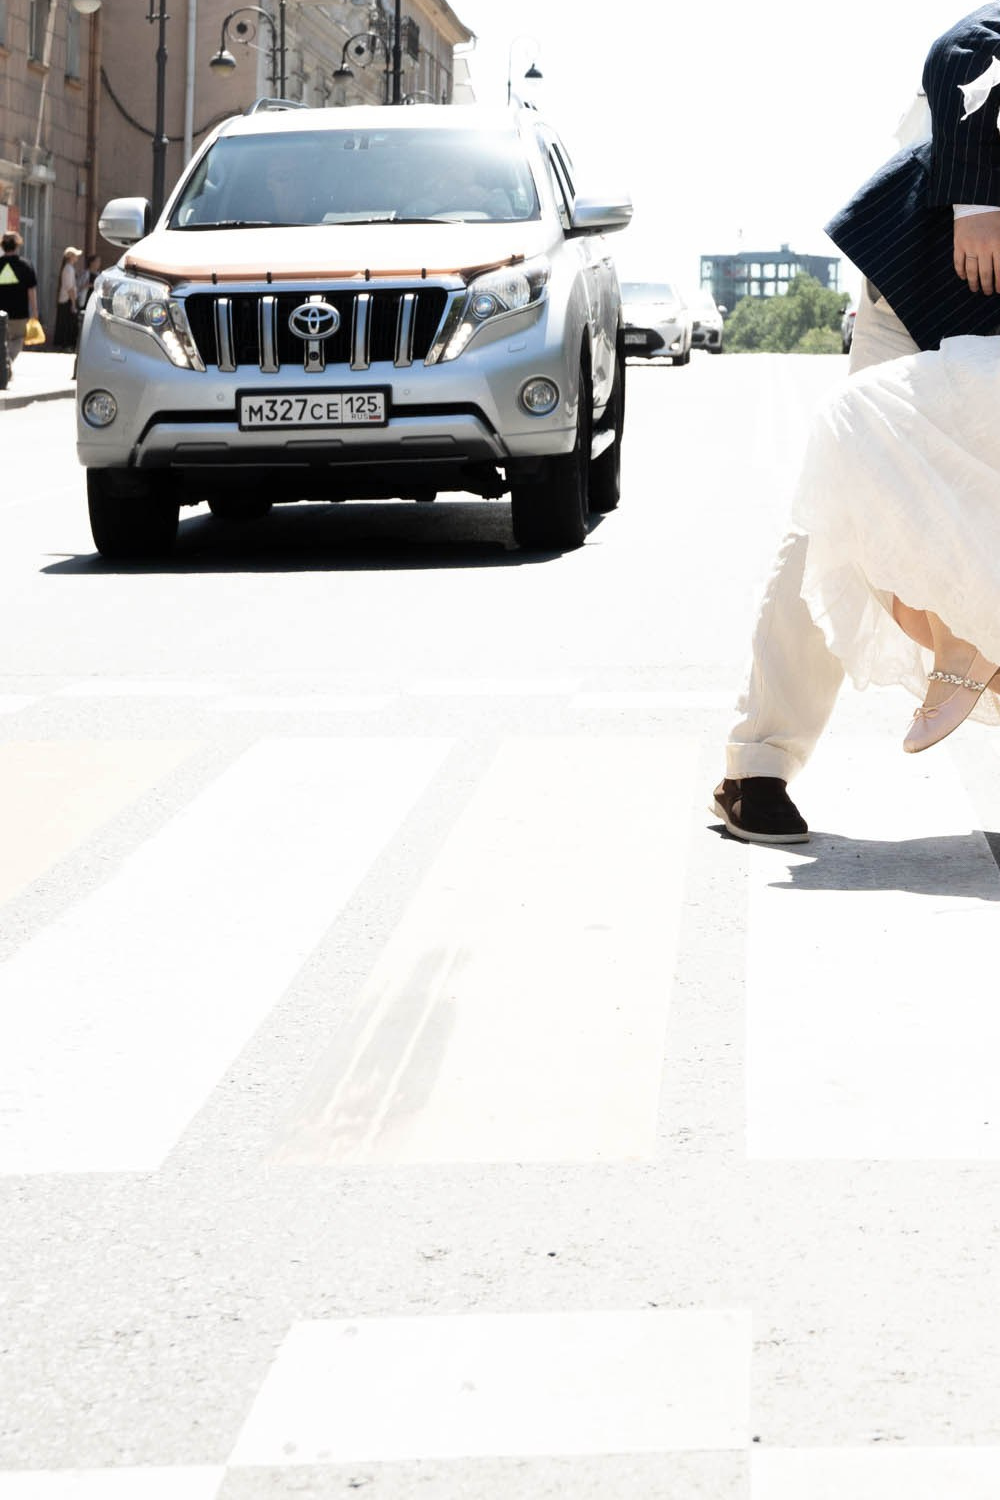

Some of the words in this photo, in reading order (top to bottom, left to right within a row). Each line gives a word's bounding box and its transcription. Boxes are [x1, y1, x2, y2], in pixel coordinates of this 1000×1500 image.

[248, 398, 339, 422] М327СЕ
[345, 396, 378, 414] 125
[351, 413, 369, 421] RUS
